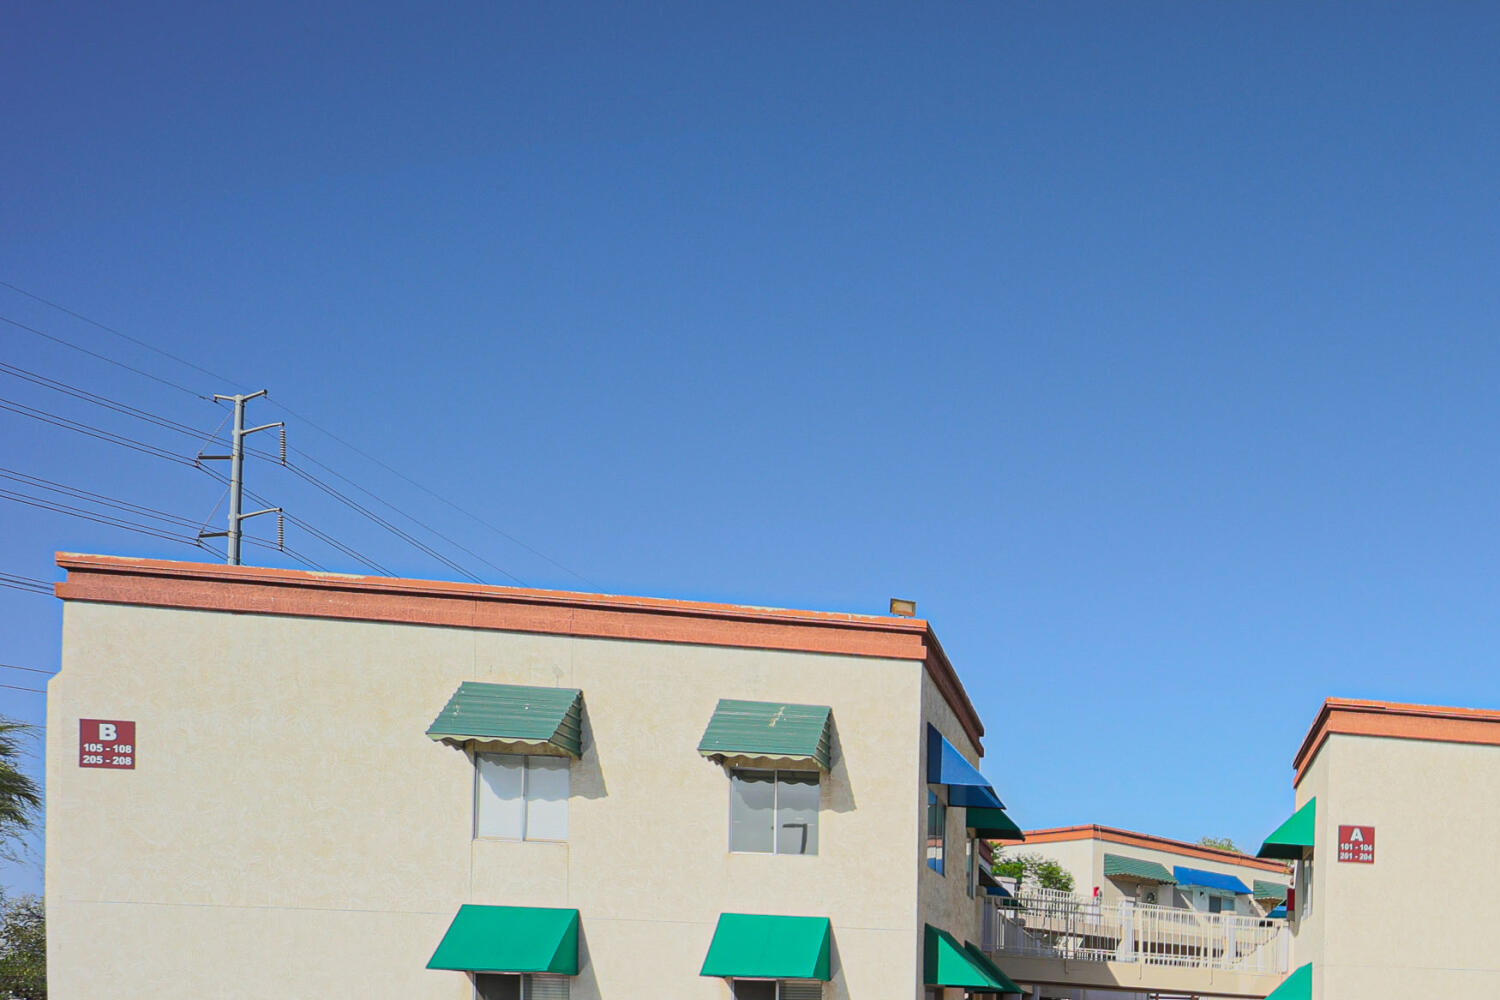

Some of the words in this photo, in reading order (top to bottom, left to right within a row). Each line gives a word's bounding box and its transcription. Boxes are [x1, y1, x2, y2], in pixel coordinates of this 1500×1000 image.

[99, 723, 117, 741] B
[83, 743, 104, 753] 105
[112, 744, 132, 754] 108
[82, 755, 104, 764] 205
[112, 756, 132, 765] 208
[1350, 828, 1364, 841] A
[1341, 843, 1353, 851] 101
[1340, 852, 1353, 860] 201
